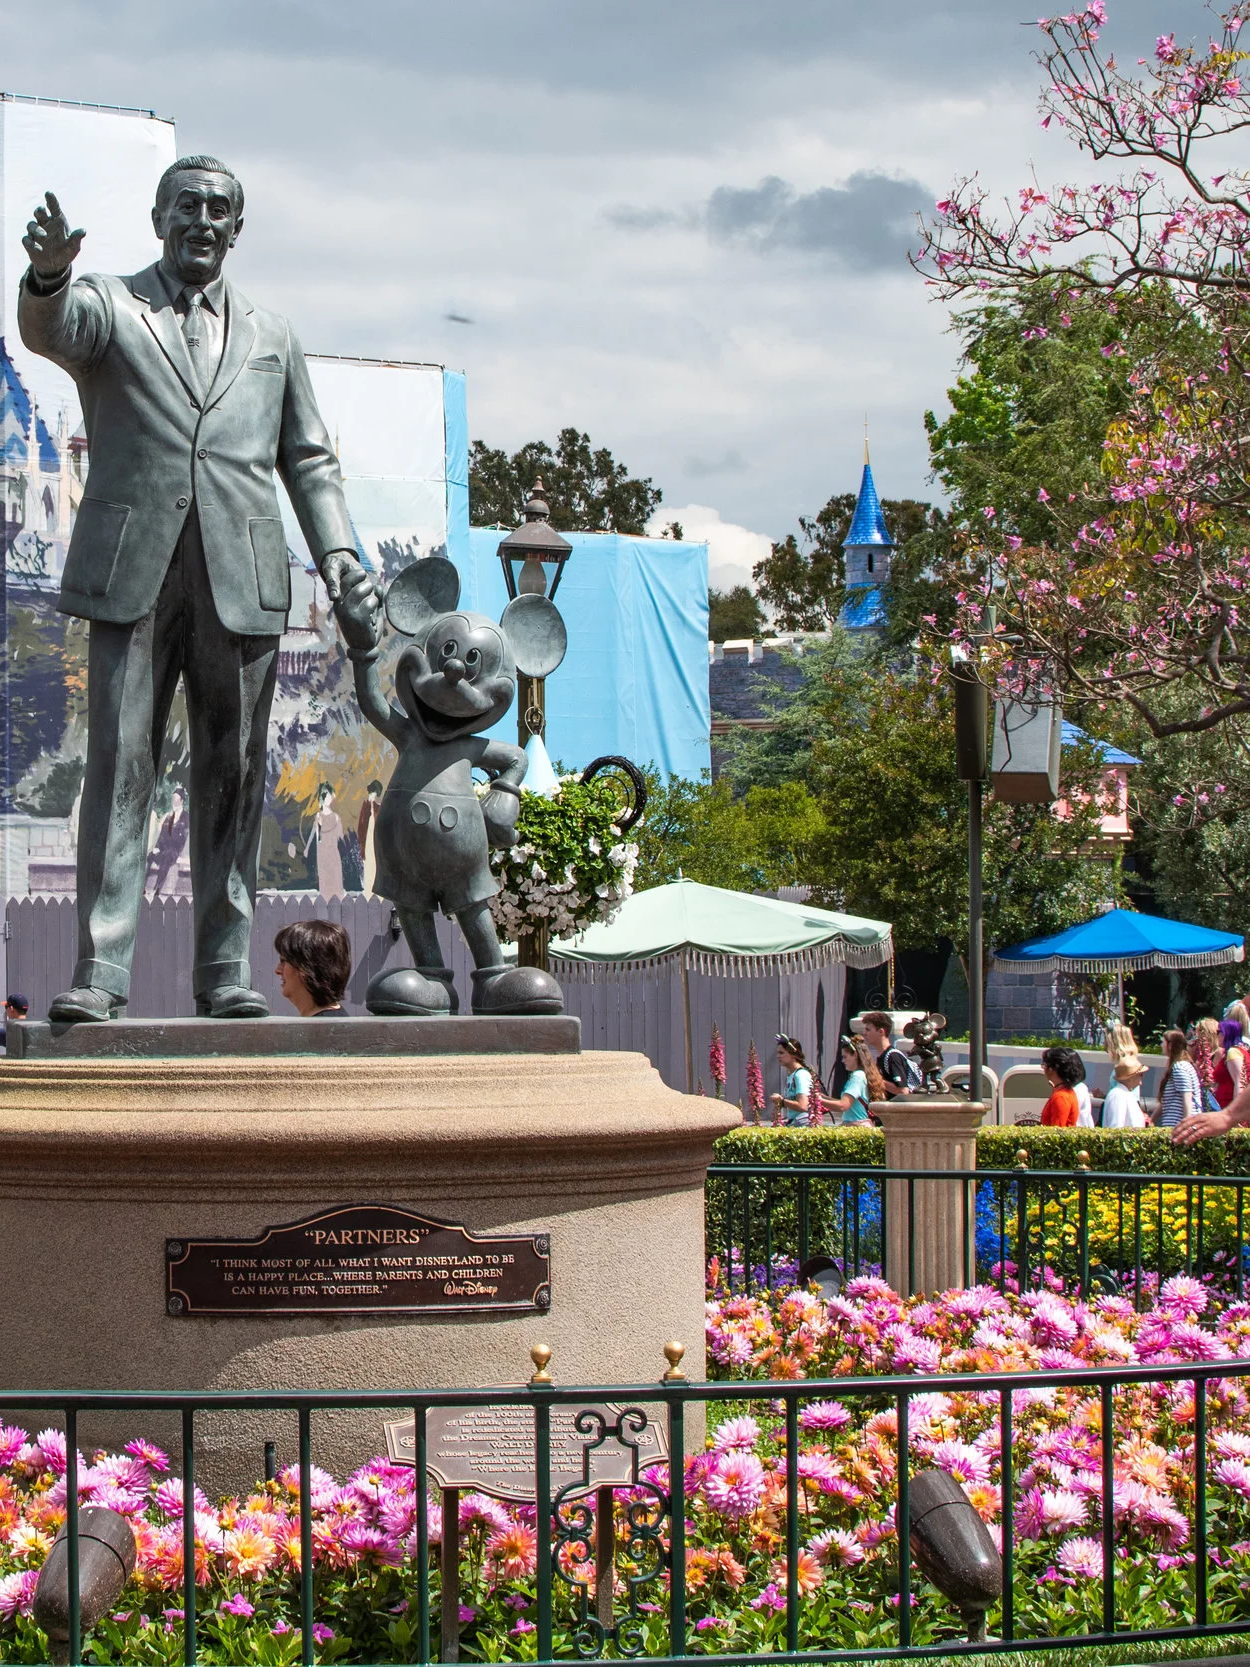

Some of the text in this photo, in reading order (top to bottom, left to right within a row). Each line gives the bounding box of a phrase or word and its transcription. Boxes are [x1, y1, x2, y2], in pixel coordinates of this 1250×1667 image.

[304, 1228, 430, 1245] “PARTNERS”
[223, 1259, 258, 1268] THINK
[261, 1259, 293, 1268] MOST
[296, 1259, 311, 1268] OF
[313, 1258, 336, 1268] ALL
[338, 1257, 371, 1267] WHAT
[373, 1257, 379, 1267] I
[382, 1257, 413, 1267] WANT
[415, 1255, 484, 1266] DISNEYLAND
[485, 1255, 500, 1264] TO
[501, 1254, 515, 1264] BE
[223, 1272, 234, 1282] IS
[237, 1272, 246, 1281] A
[248, 1272, 285, 1282] HAPPY
[375, 1270, 423, 1281] PARENTS
[425, 1269, 450, 1280] AND
[452, 1268, 504, 1279] CHILDREN
[231, 1286, 256, 1296] CAN
[259, 1286, 290, 1296] HAVE
[464, 1411, 476, 1419] of
[477, 1411, 494, 1419] the
[495, 1411, 523, 1419] 100th
[458, 1419, 473, 1427] his
[474, 1419, 502, 1427] birth,
[471, 1426, 524, 1434] rededicated
[459, 1434, 499, 1442] Dreams,
[490, 1441, 567, 1449] WALT DNEY
[436, 1450, 467, 1458] whose
[468, 1450, 498, 1459] legacy
[469, 1457, 504, 1465] around
[505, 1457, 521, 1465] the
[511, 1465, 527, 1473] the
